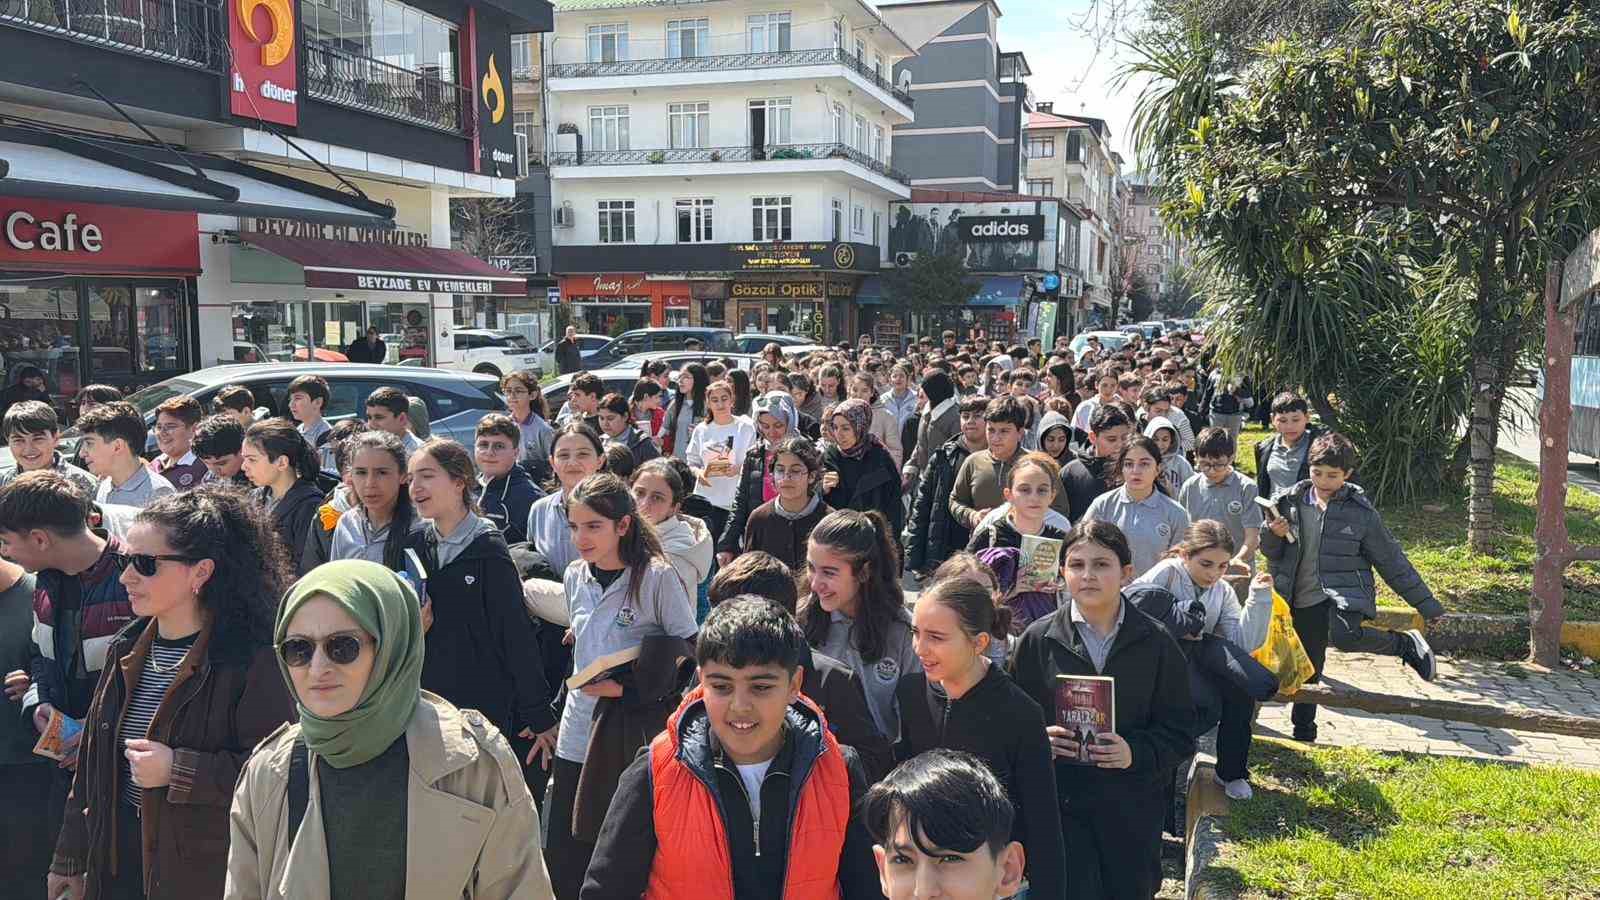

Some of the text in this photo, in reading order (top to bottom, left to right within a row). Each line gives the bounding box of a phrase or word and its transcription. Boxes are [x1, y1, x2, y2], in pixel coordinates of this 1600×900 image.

[261, 80, 297, 104] döner
[7, 211, 102, 252] Cafe
[971, 221, 1029, 236] adidas
[358, 276, 492, 293] BEYZADE EV YEMEKLERİ
[732, 283, 775, 296] Gözcü
[782, 283, 817, 297] Optik
